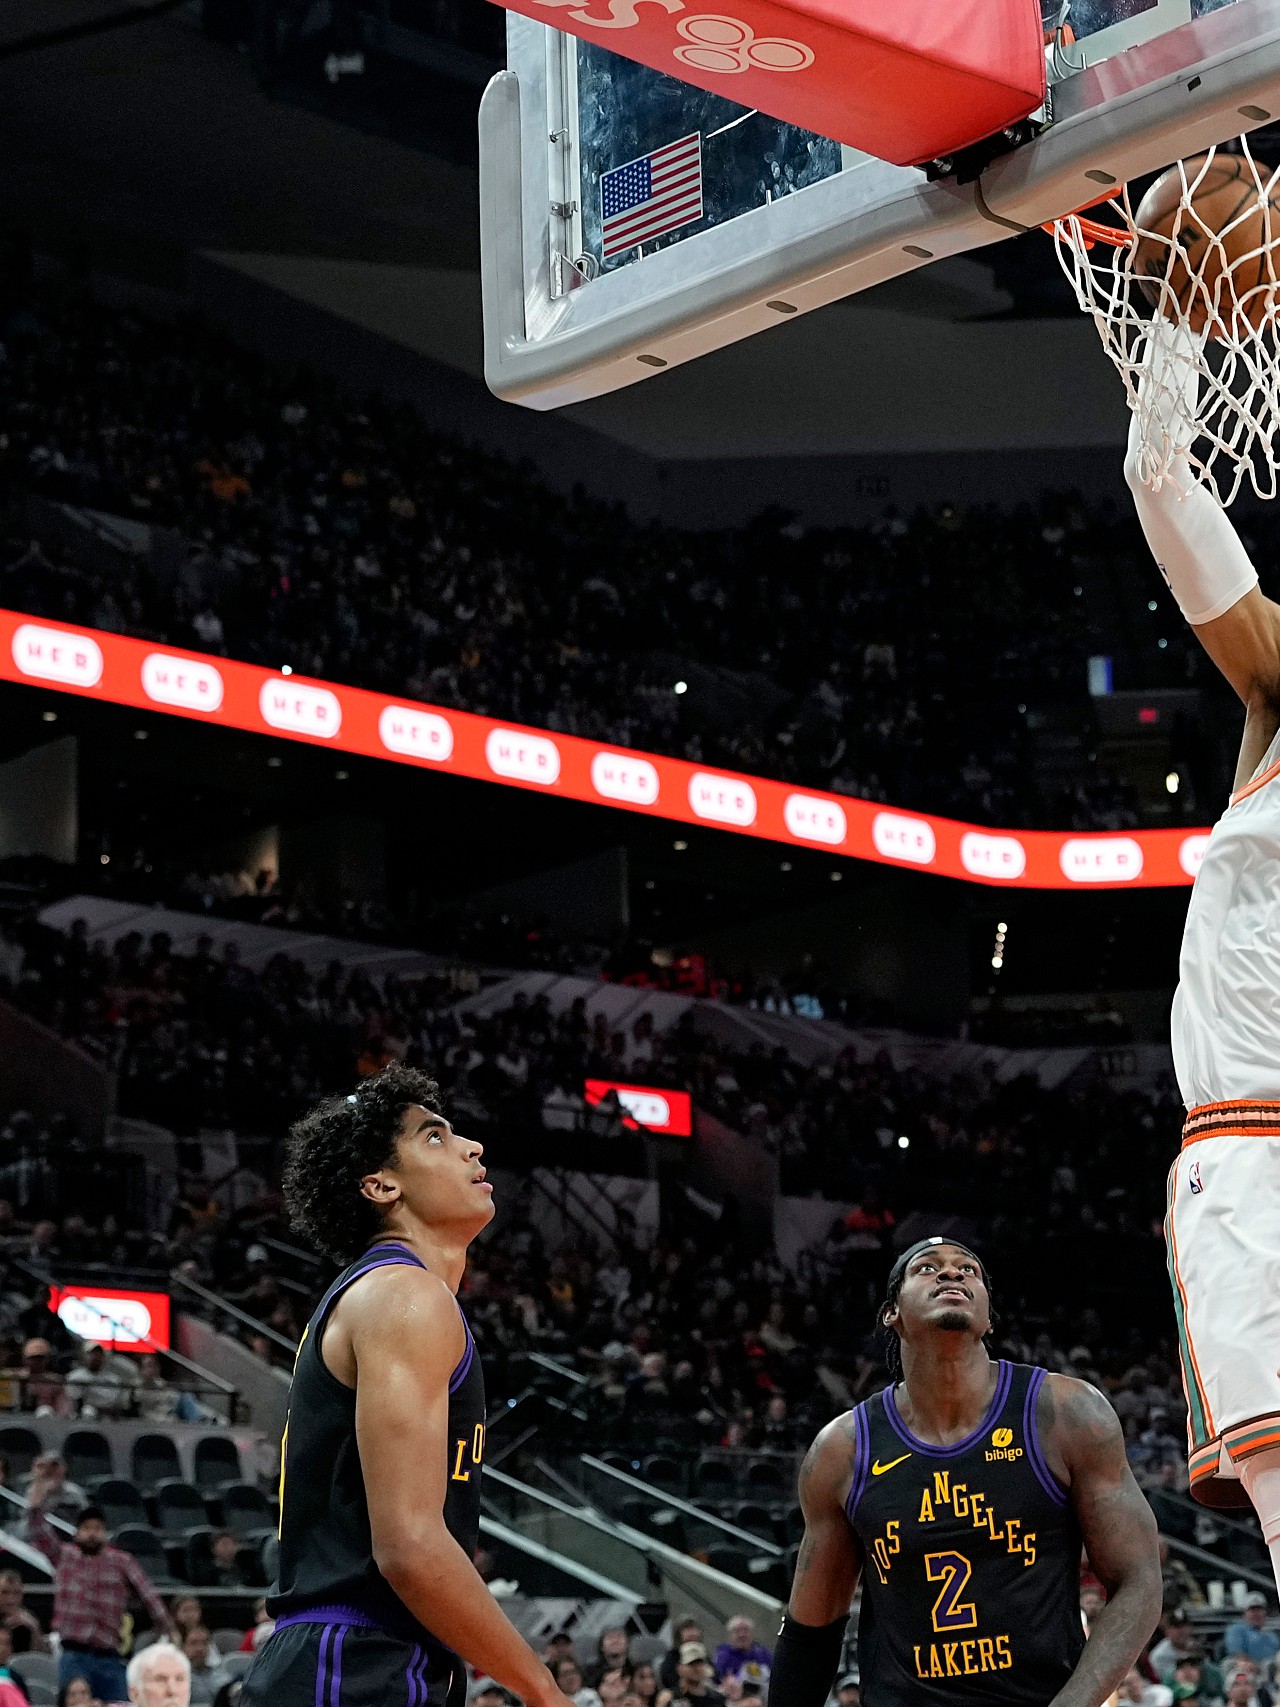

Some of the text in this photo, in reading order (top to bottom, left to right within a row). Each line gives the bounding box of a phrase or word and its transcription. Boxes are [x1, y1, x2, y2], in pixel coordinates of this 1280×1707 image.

[984, 1447, 1023, 1462] bibigo
[871, 1471, 1036, 1584] LOS ANGELES
[924, 1550, 977, 1632] 2
[913, 1635, 1013, 1678] LAKERS
